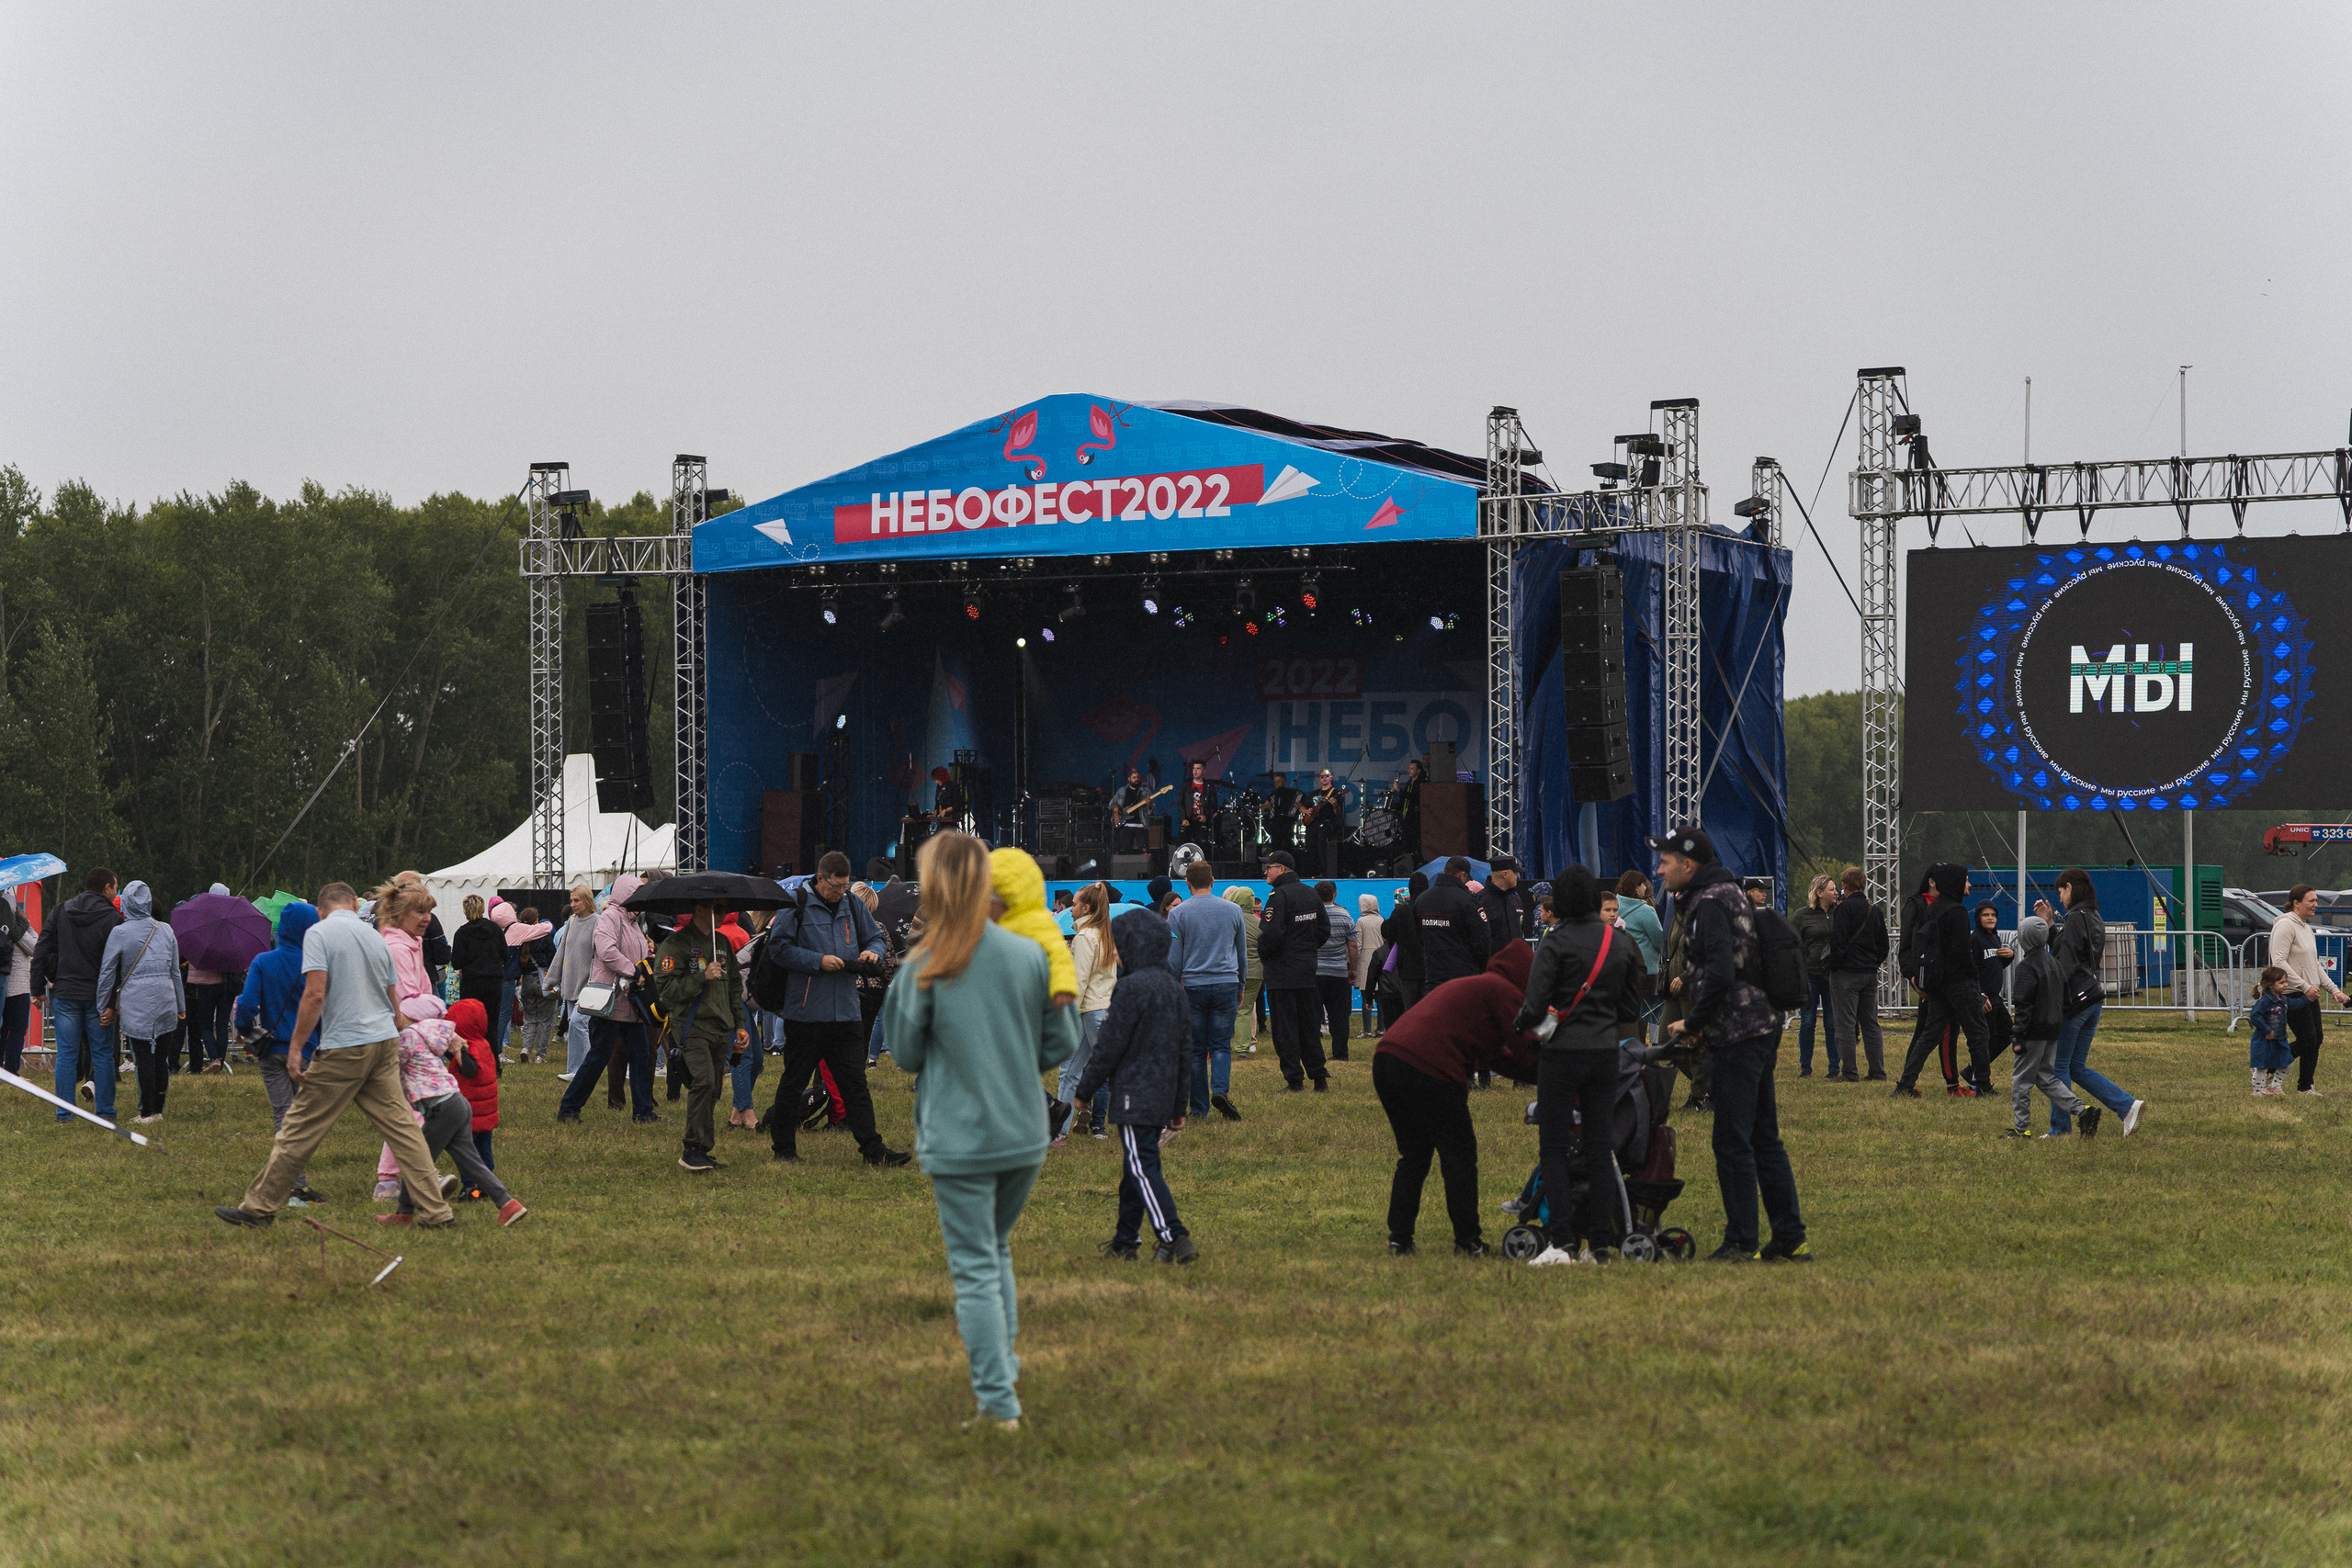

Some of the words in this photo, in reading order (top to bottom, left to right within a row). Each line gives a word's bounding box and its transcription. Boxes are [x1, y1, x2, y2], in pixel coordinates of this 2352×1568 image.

[871, 473, 1231, 534] НЕБОФЕСТ2022
[2088, 567, 2102, 576] мы
[2107, 558, 2145, 570] русские
[2166, 565, 2202, 584] русские
[2054, 571, 2086, 598] русские
[2201, 582, 2215, 595] мы
[2041, 599, 2052, 613] мы
[2216, 596, 2242, 629] русские
[2021, 612, 2042, 648] русские
[2236, 630, 2245, 645] мы
[2017, 652, 2025, 666] мы
[2242, 649, 2252, 688] русские
[1264, 658, 1357, 694] 2022
[2014, 669, 2023, 706] русские
[2241, 691, 2248, 705] мы
[1278, 698, 1472, 763] НЕБО
[2019, 711, 2029, 725] мы
[2024, 727, 2048, 759] русские
[2211, 746, 2223, 759] мы
[2222, 709, 2244, 747] русские
[2049, 761, 2062, 773] мы
[2061, 771, 2097, 791] русские
[2160, 782, 2174, 791] мы
[2176, 761, 2210, 786] русские
[2101, 787, 2115, 795] мы
[2117, 788, 2155, 798] русские
[1295, 912, 1317, 922] ПОЛИЦИЯ
[1421, 919, 1451, 928] ПОЛИЦИЯ
